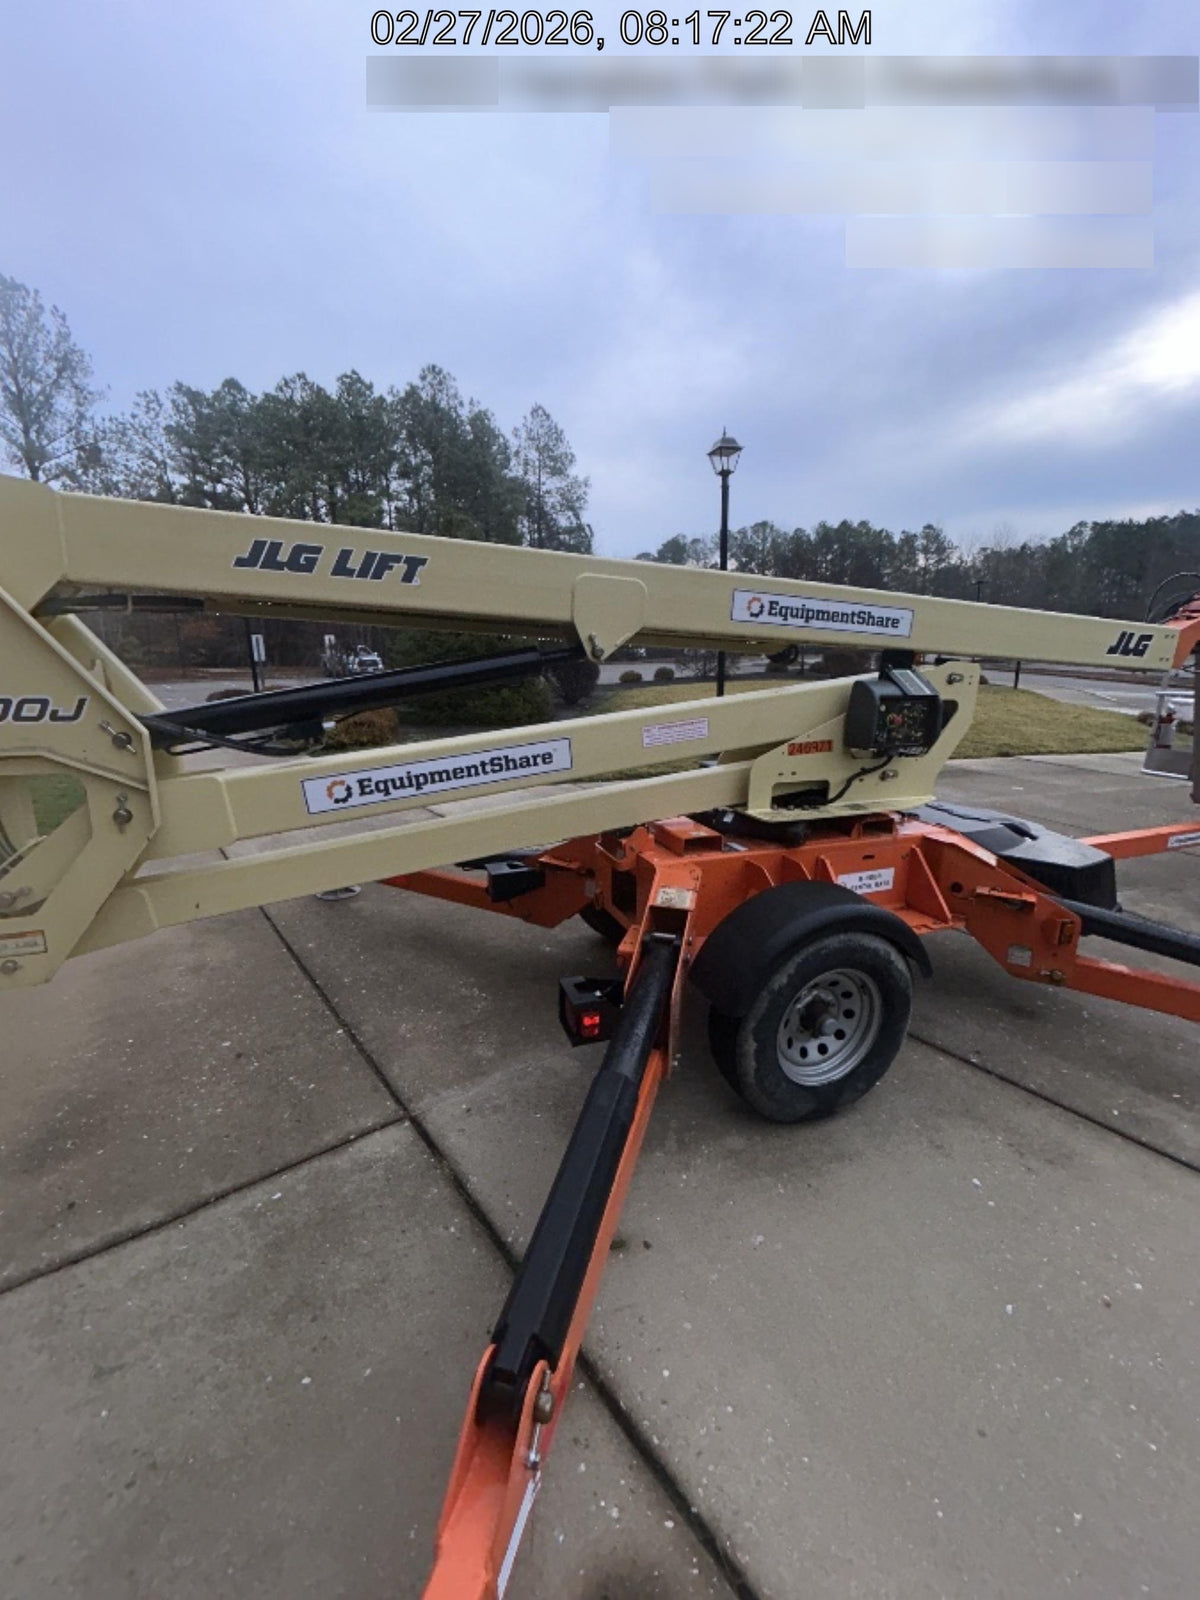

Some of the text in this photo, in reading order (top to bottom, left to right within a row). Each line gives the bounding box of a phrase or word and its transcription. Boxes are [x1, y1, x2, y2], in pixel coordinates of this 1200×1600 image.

[233, 539, 429, 584] JLG LIFT
[767, 600, 900, 629] EquipmentShare
[1106, 630, 1154, 657] JLG
[357, 750, 555, 797] EquipmentShare
